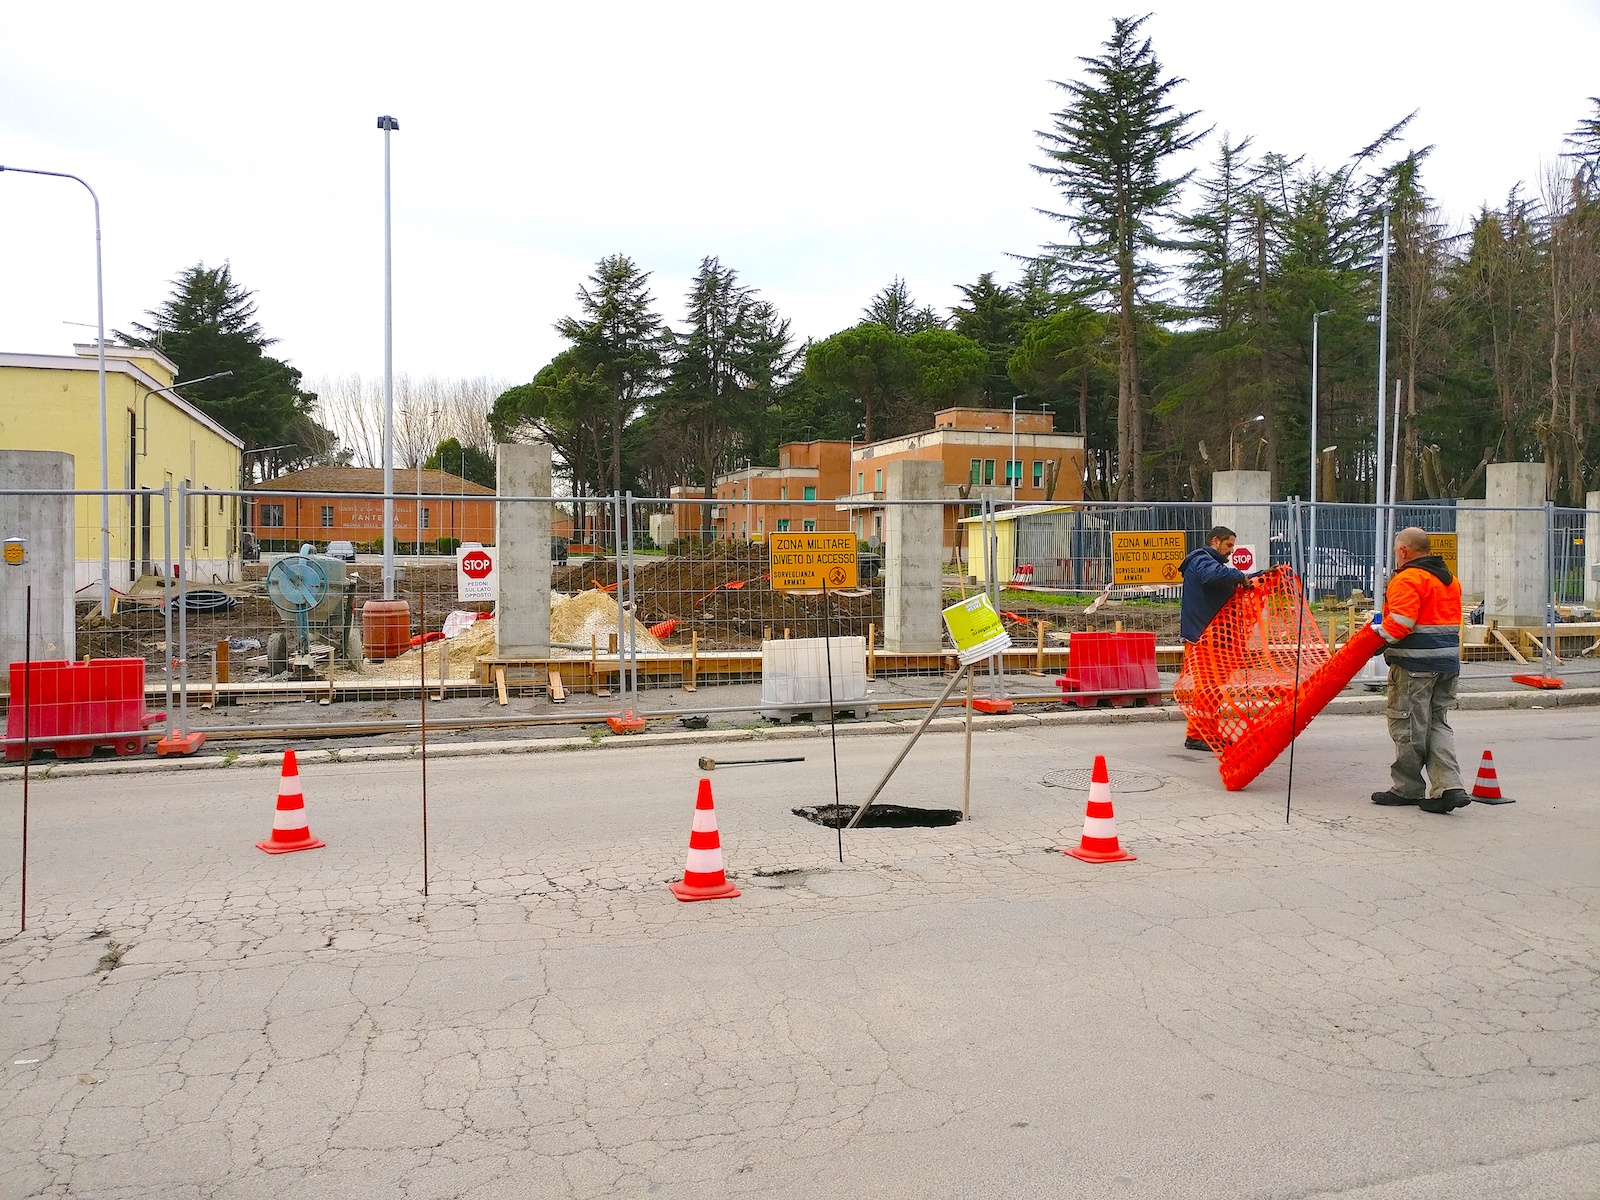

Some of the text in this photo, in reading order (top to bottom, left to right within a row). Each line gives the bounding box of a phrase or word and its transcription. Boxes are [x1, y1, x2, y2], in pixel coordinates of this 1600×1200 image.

[777, 539, 850, 549] ZONA MILITARE
[1118, 538, 1180, 547] ZONA MILITARE
[774, 554, 854, 564] DIVIETO DI ACCESSO
[1115, 551, 1184, 561] DIVIETO DI ACCESSO
[1233, 555, 1251, 564] STOP
[464, 560, 490, 570] STOP
